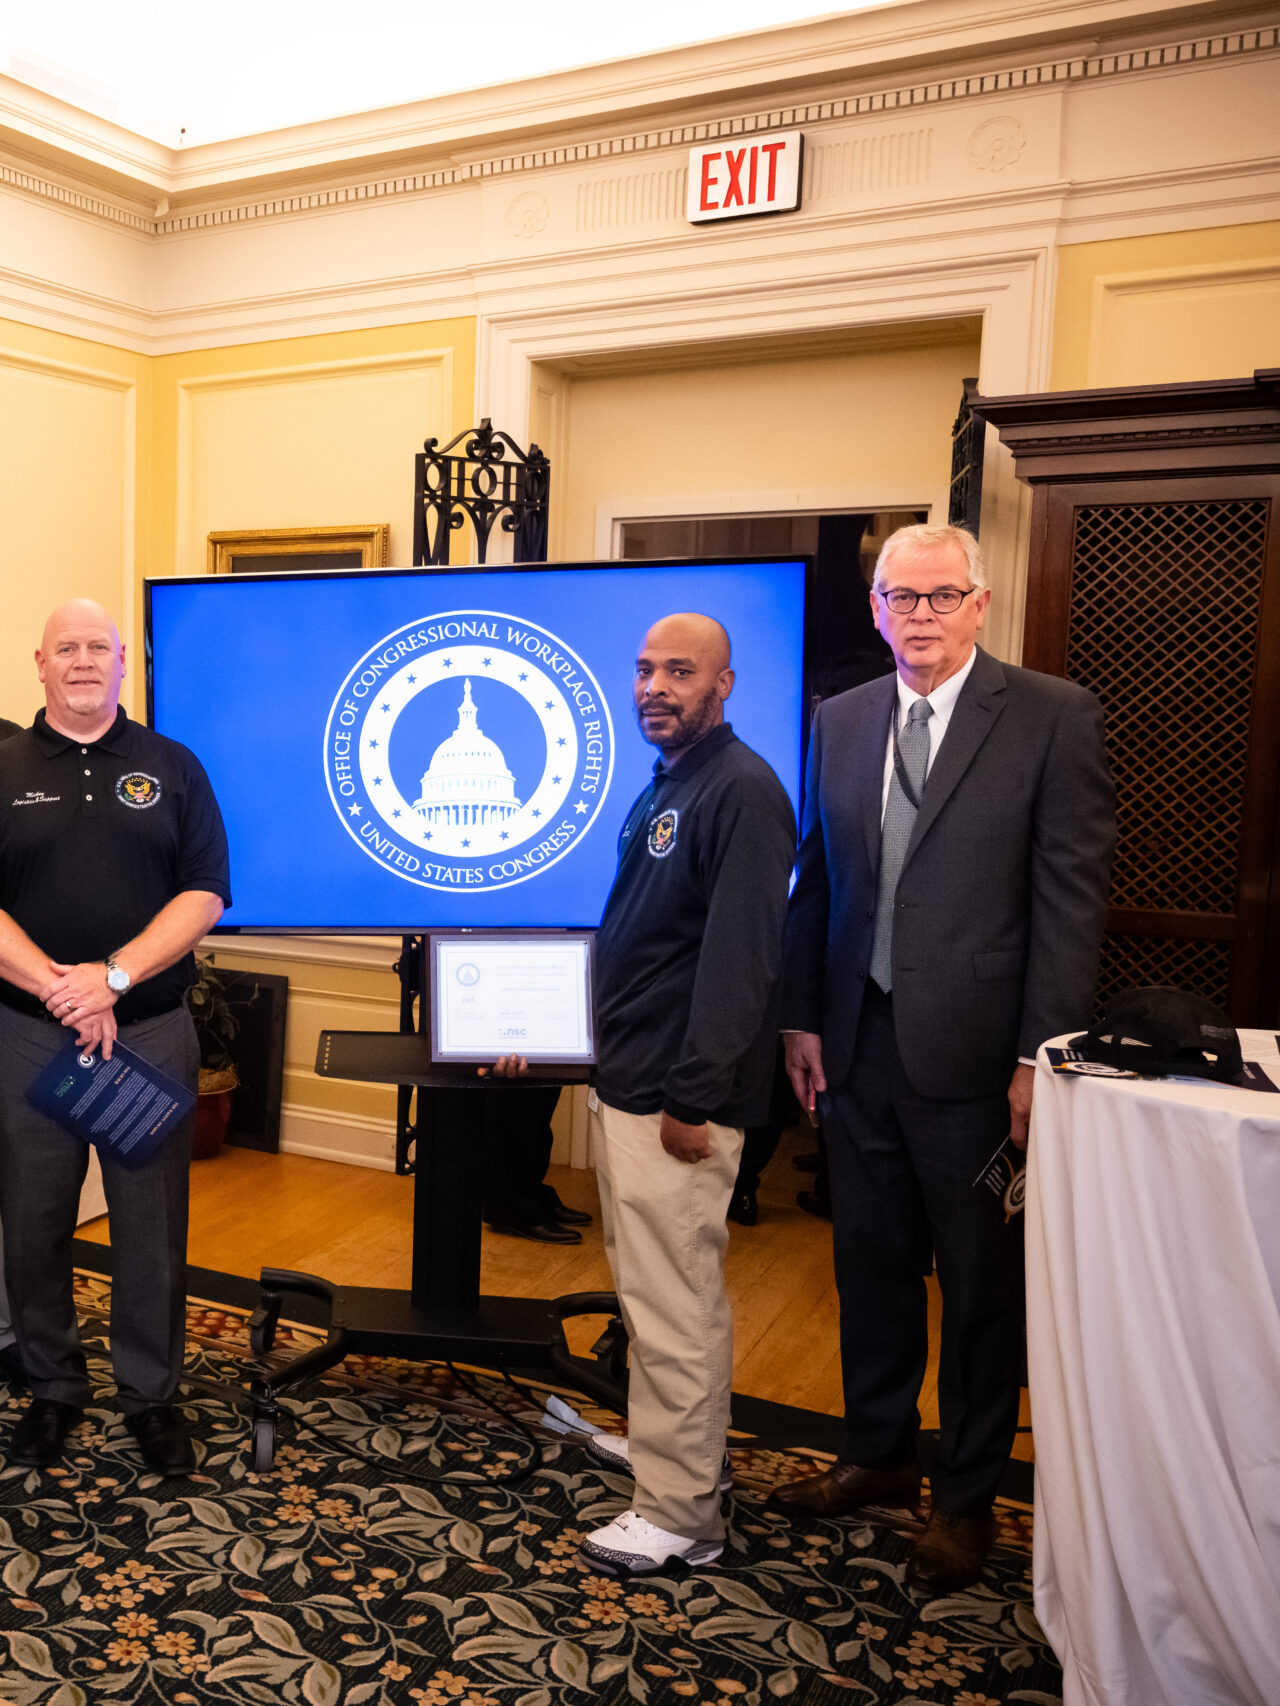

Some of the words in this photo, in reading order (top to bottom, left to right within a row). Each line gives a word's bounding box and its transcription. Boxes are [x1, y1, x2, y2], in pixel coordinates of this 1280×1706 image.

[699, 141, 786, 211] EXIT
[352, 620, 500, 698] CONGRESSIONAL
[506, 626, 597, 717] WORKPLACE
[339, 699, 360, 727] OF
[334, 731, 355, 797] OFFICE
[581, 719, 603, 794] RIGHTS
[359, 820, 420, 874] UNITED
[422, 862, 484, 884] STATES
[488, 819, 577, 880] CONGRESS
[507, 1027, 528, 1036] nsc
